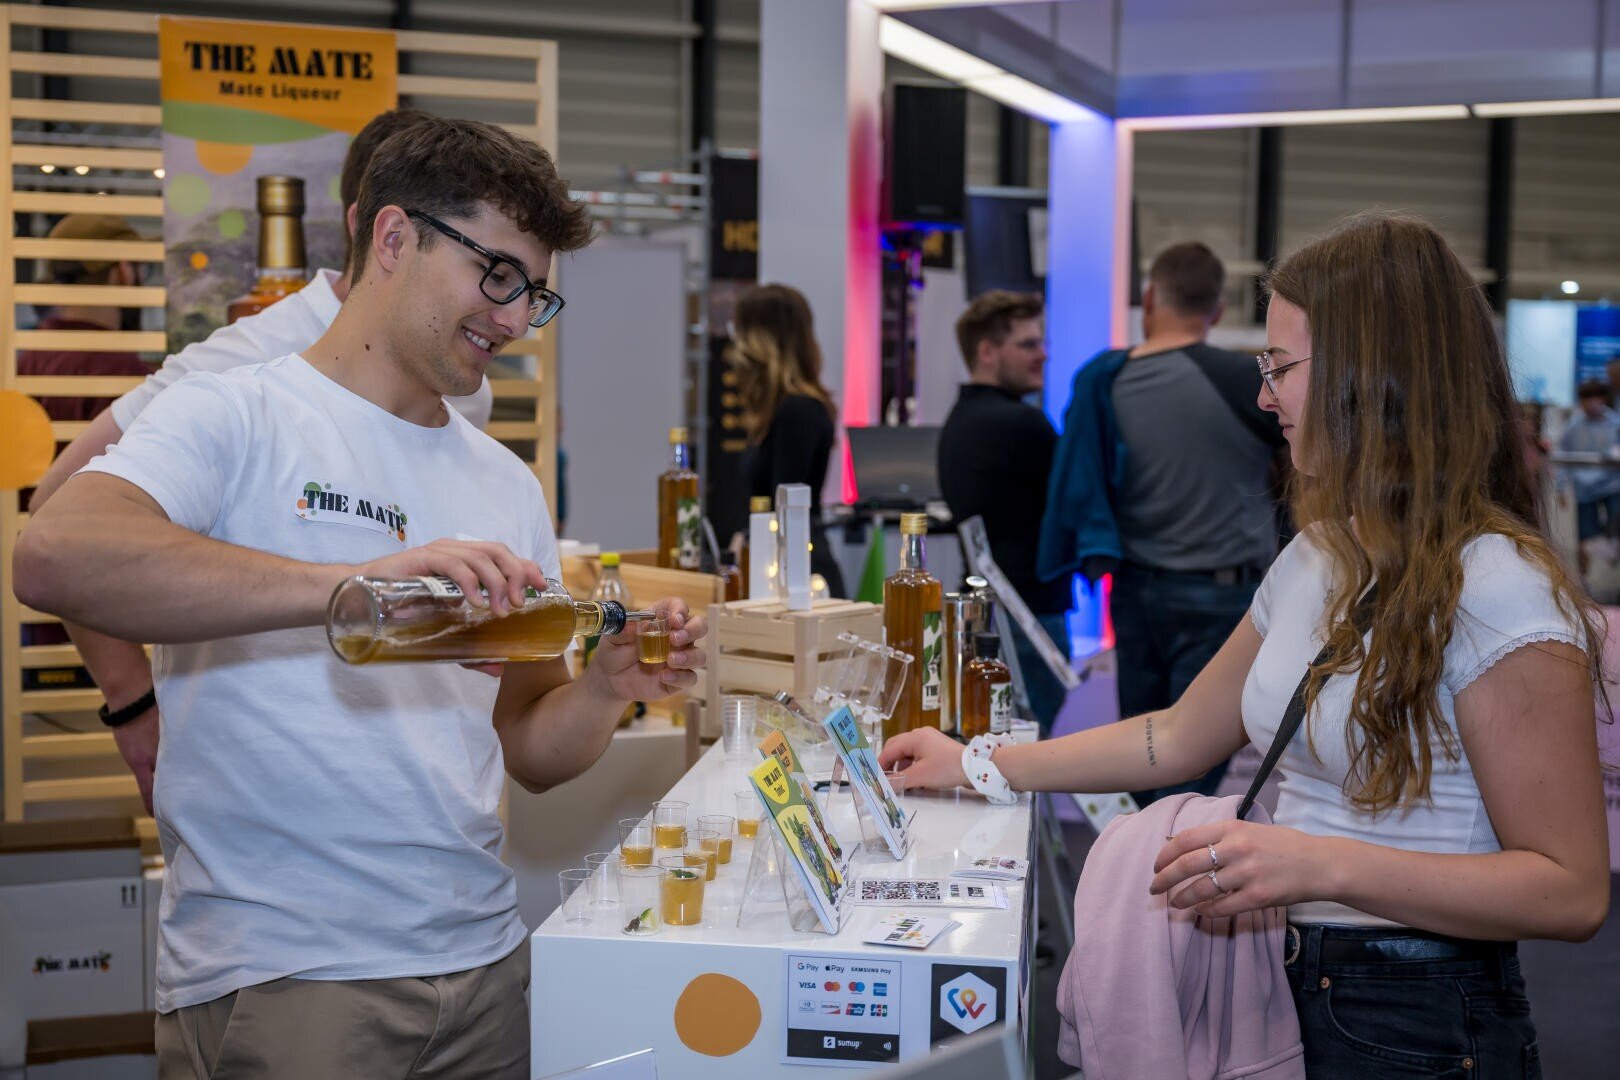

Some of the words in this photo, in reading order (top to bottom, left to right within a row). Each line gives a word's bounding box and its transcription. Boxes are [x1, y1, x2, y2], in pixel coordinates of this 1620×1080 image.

[184, 41, 256, 73] THE
[268, 47, 374, 80] MATE
[219, 81, 264, 97] Mate
[271, 83, 342, 101] Liqueur
[303, 489, 349, 513] THE
[355, 499, 406, 534] MATE
[1145, 717, 1157, 767] MOUNTAINS
[806, 963, 819, 972] Pay
[831, 965, 844, 974] Pay
[799, 981, 817, 989] VISA
[837, 1040, 860, 1050] sumup
